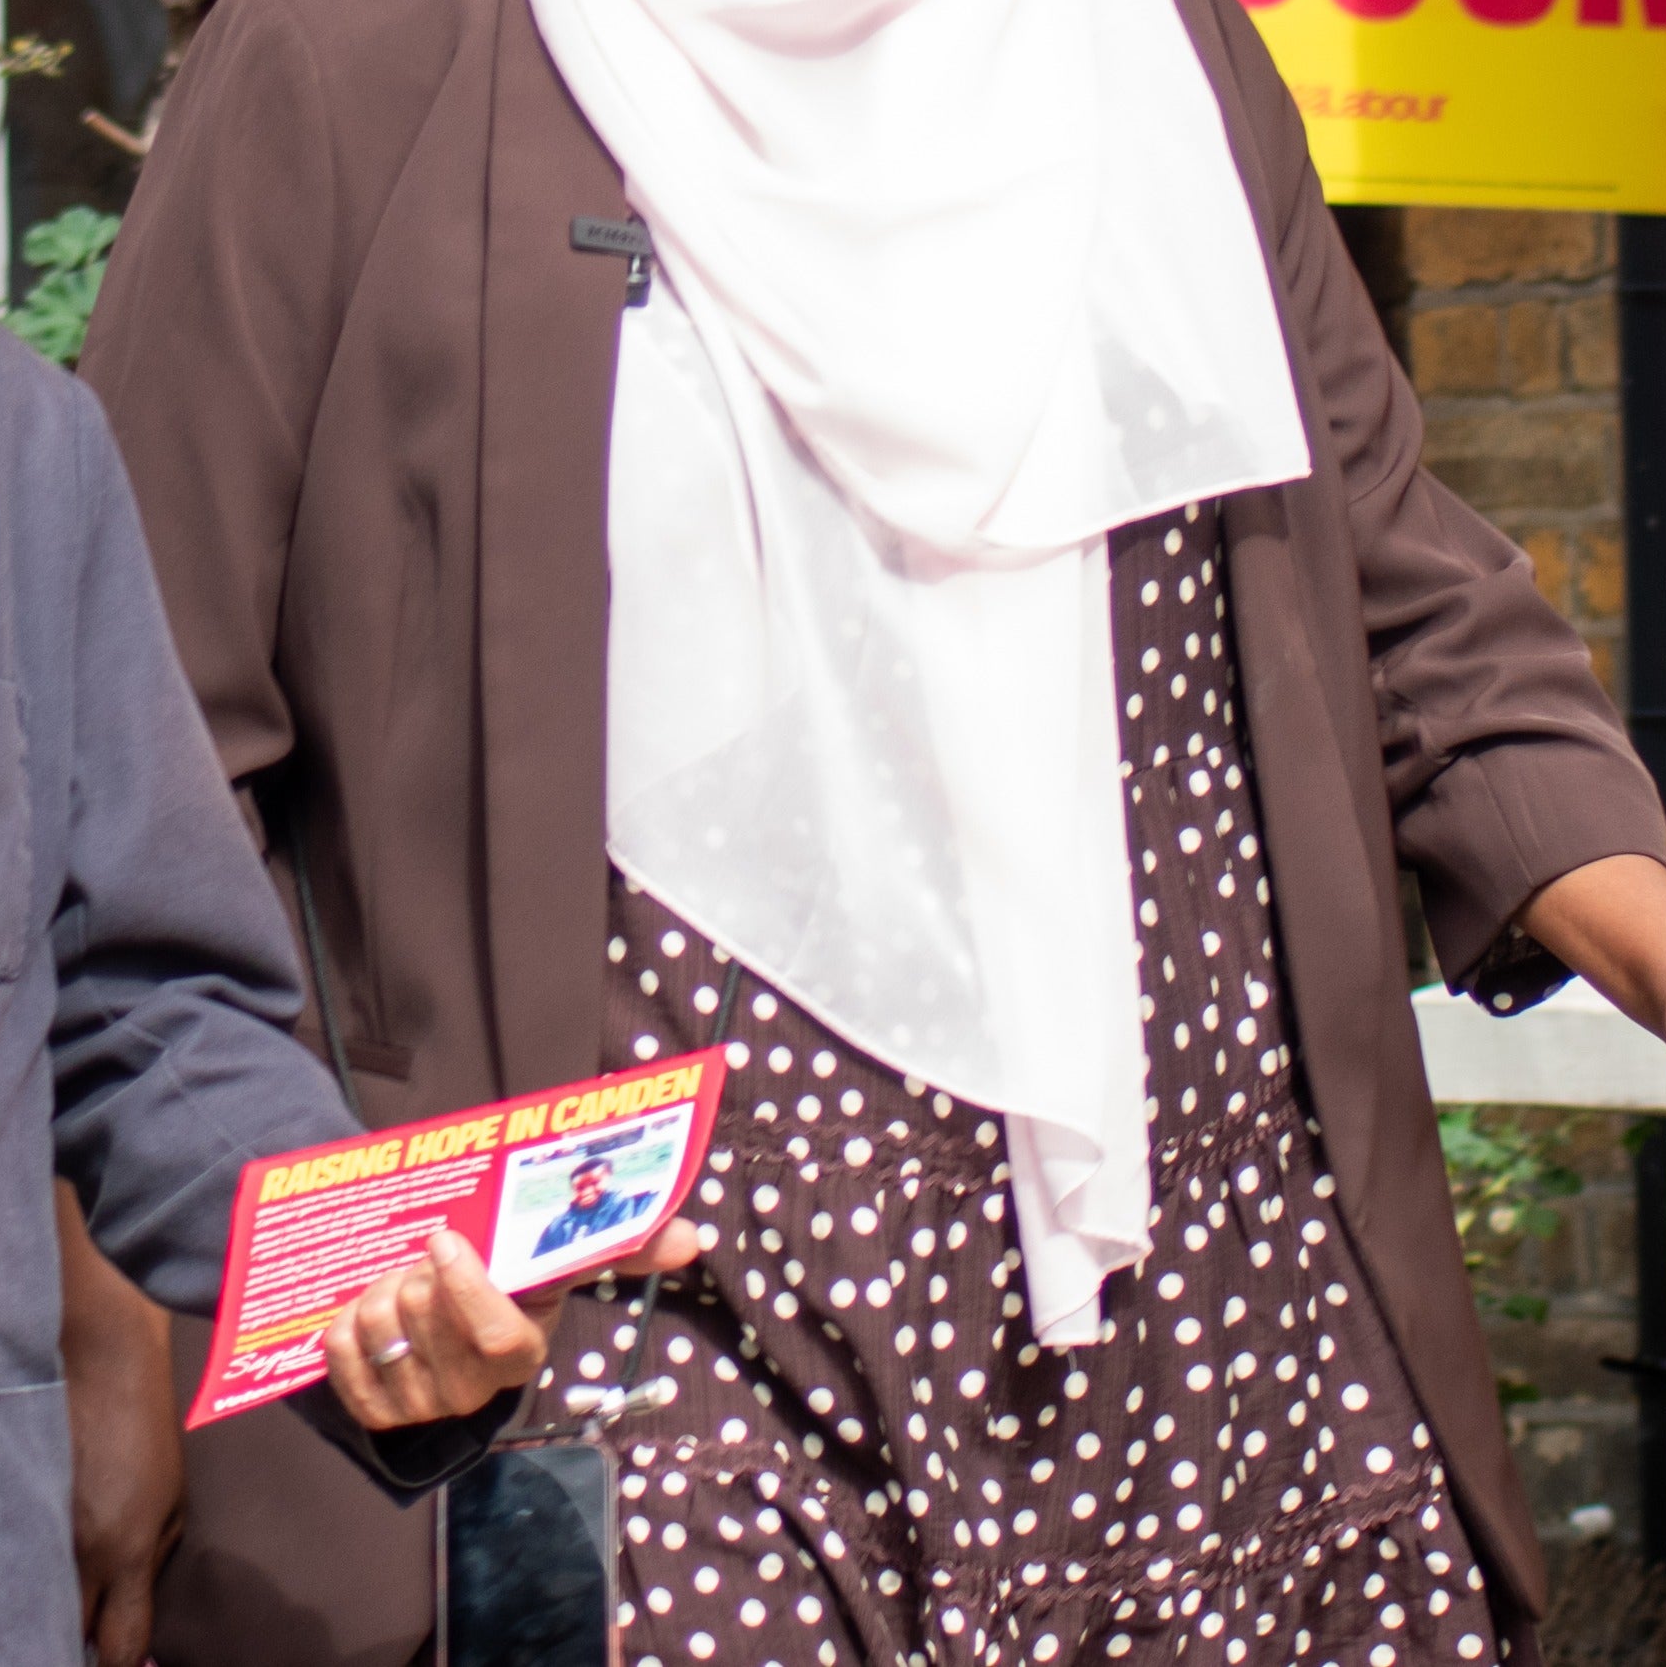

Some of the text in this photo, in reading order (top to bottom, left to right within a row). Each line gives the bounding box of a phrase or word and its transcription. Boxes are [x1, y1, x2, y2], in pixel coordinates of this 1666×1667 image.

[258, 1144, 403, 1204] RAISING
[404, 1113, 505, 1169] HOPE
[503, 1103, 550, 1145] IN
[549, 1063, 704, 1133] CAMDEN
